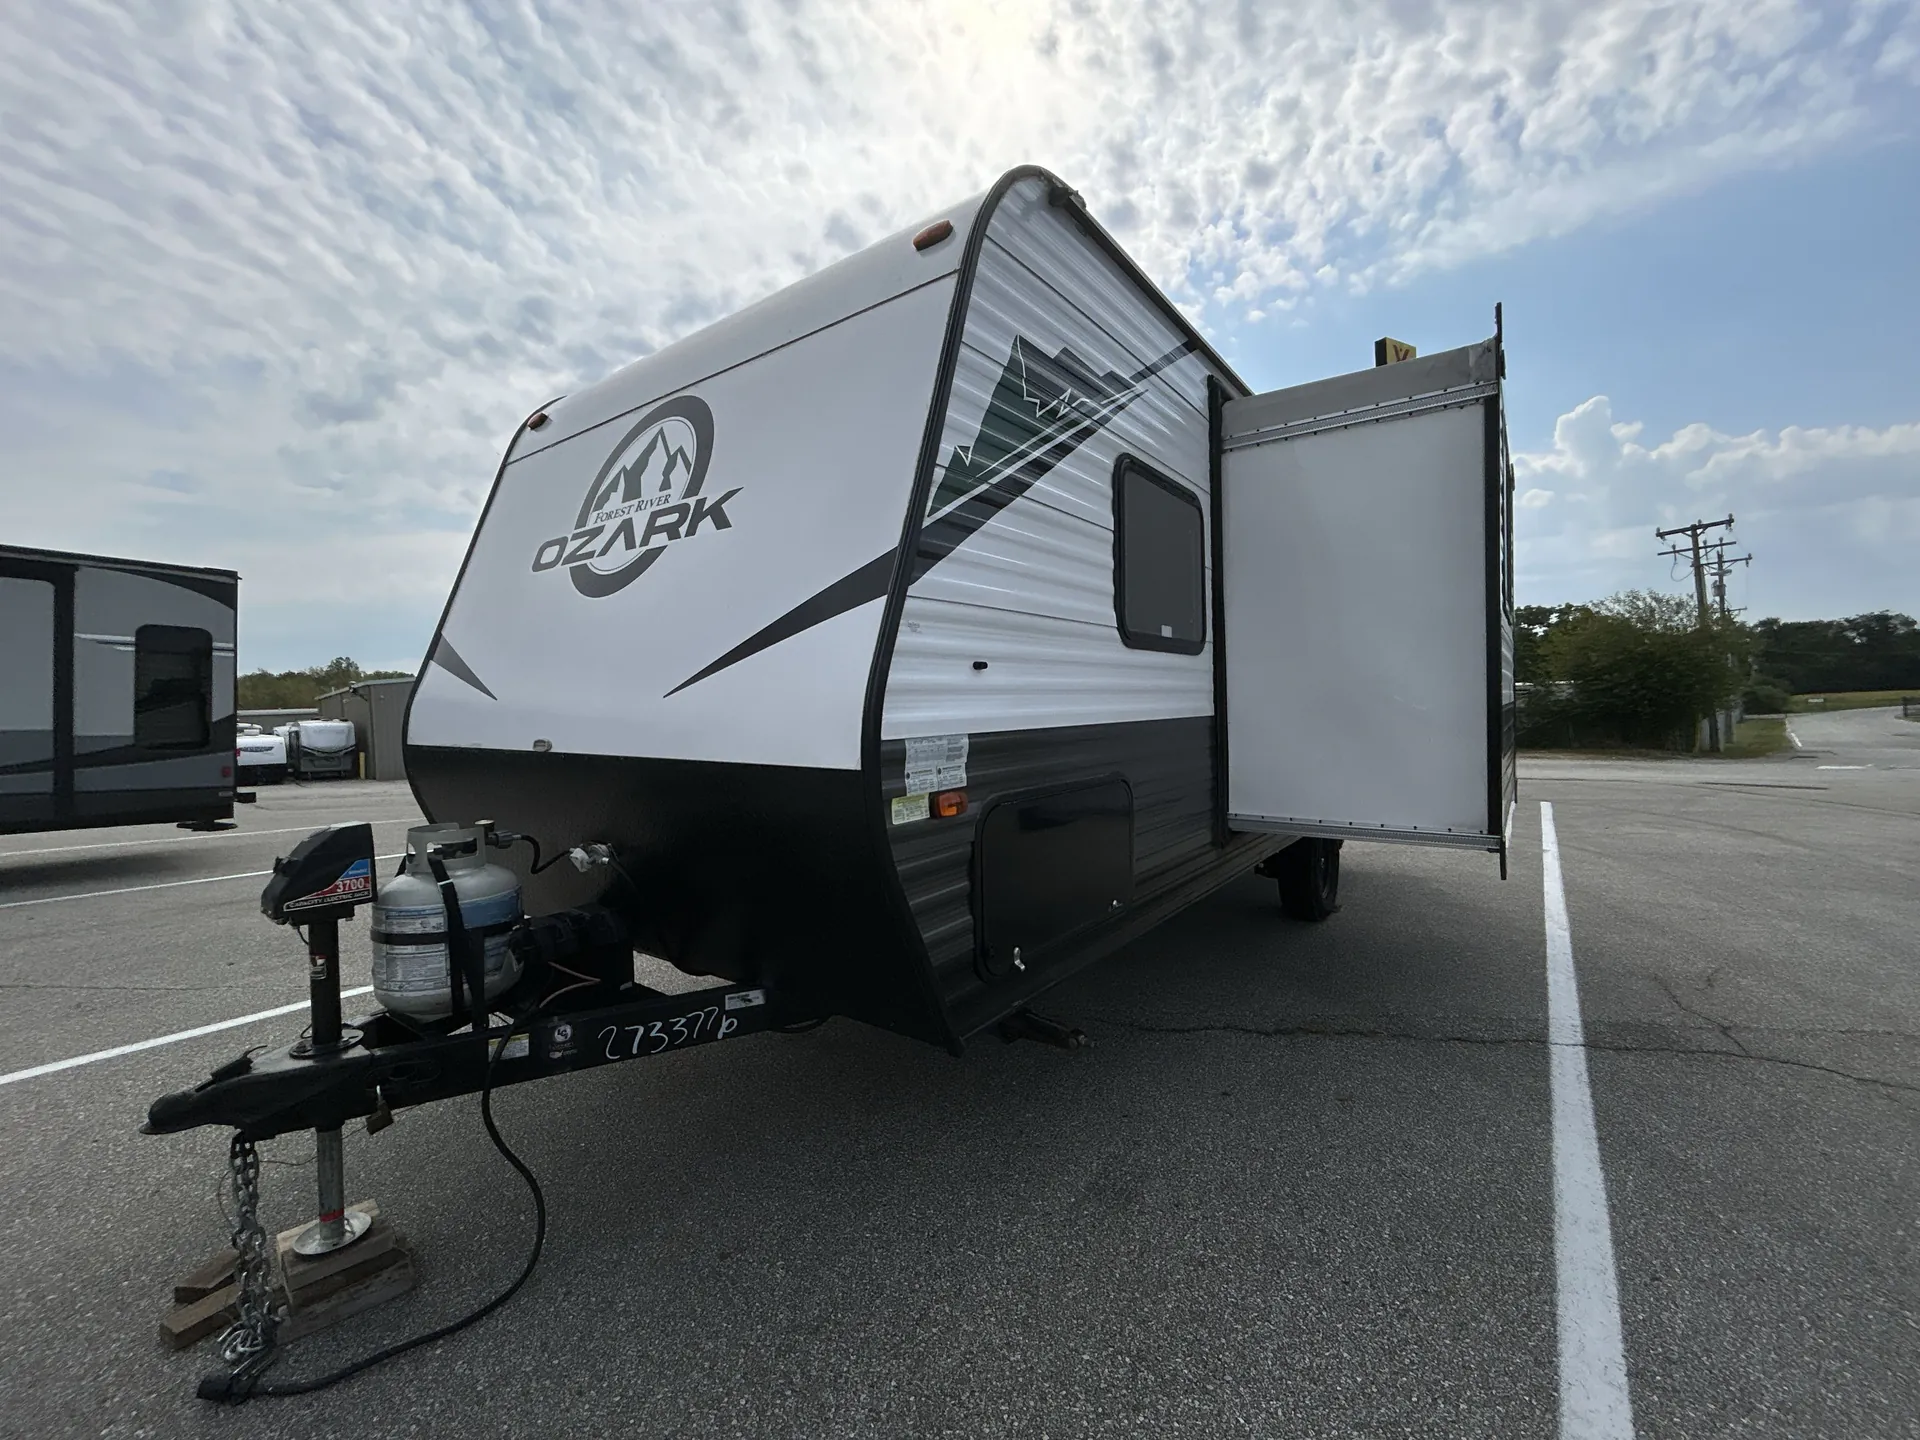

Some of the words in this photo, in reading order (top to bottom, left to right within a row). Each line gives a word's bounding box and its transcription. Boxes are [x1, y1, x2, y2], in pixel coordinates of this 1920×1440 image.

[593, 504, 635, 525] FOREST
[634, 493, 672, 513] RIVER
[531, 486, 745, 573] OZARK
[336, 877, 365, 893] 3700
